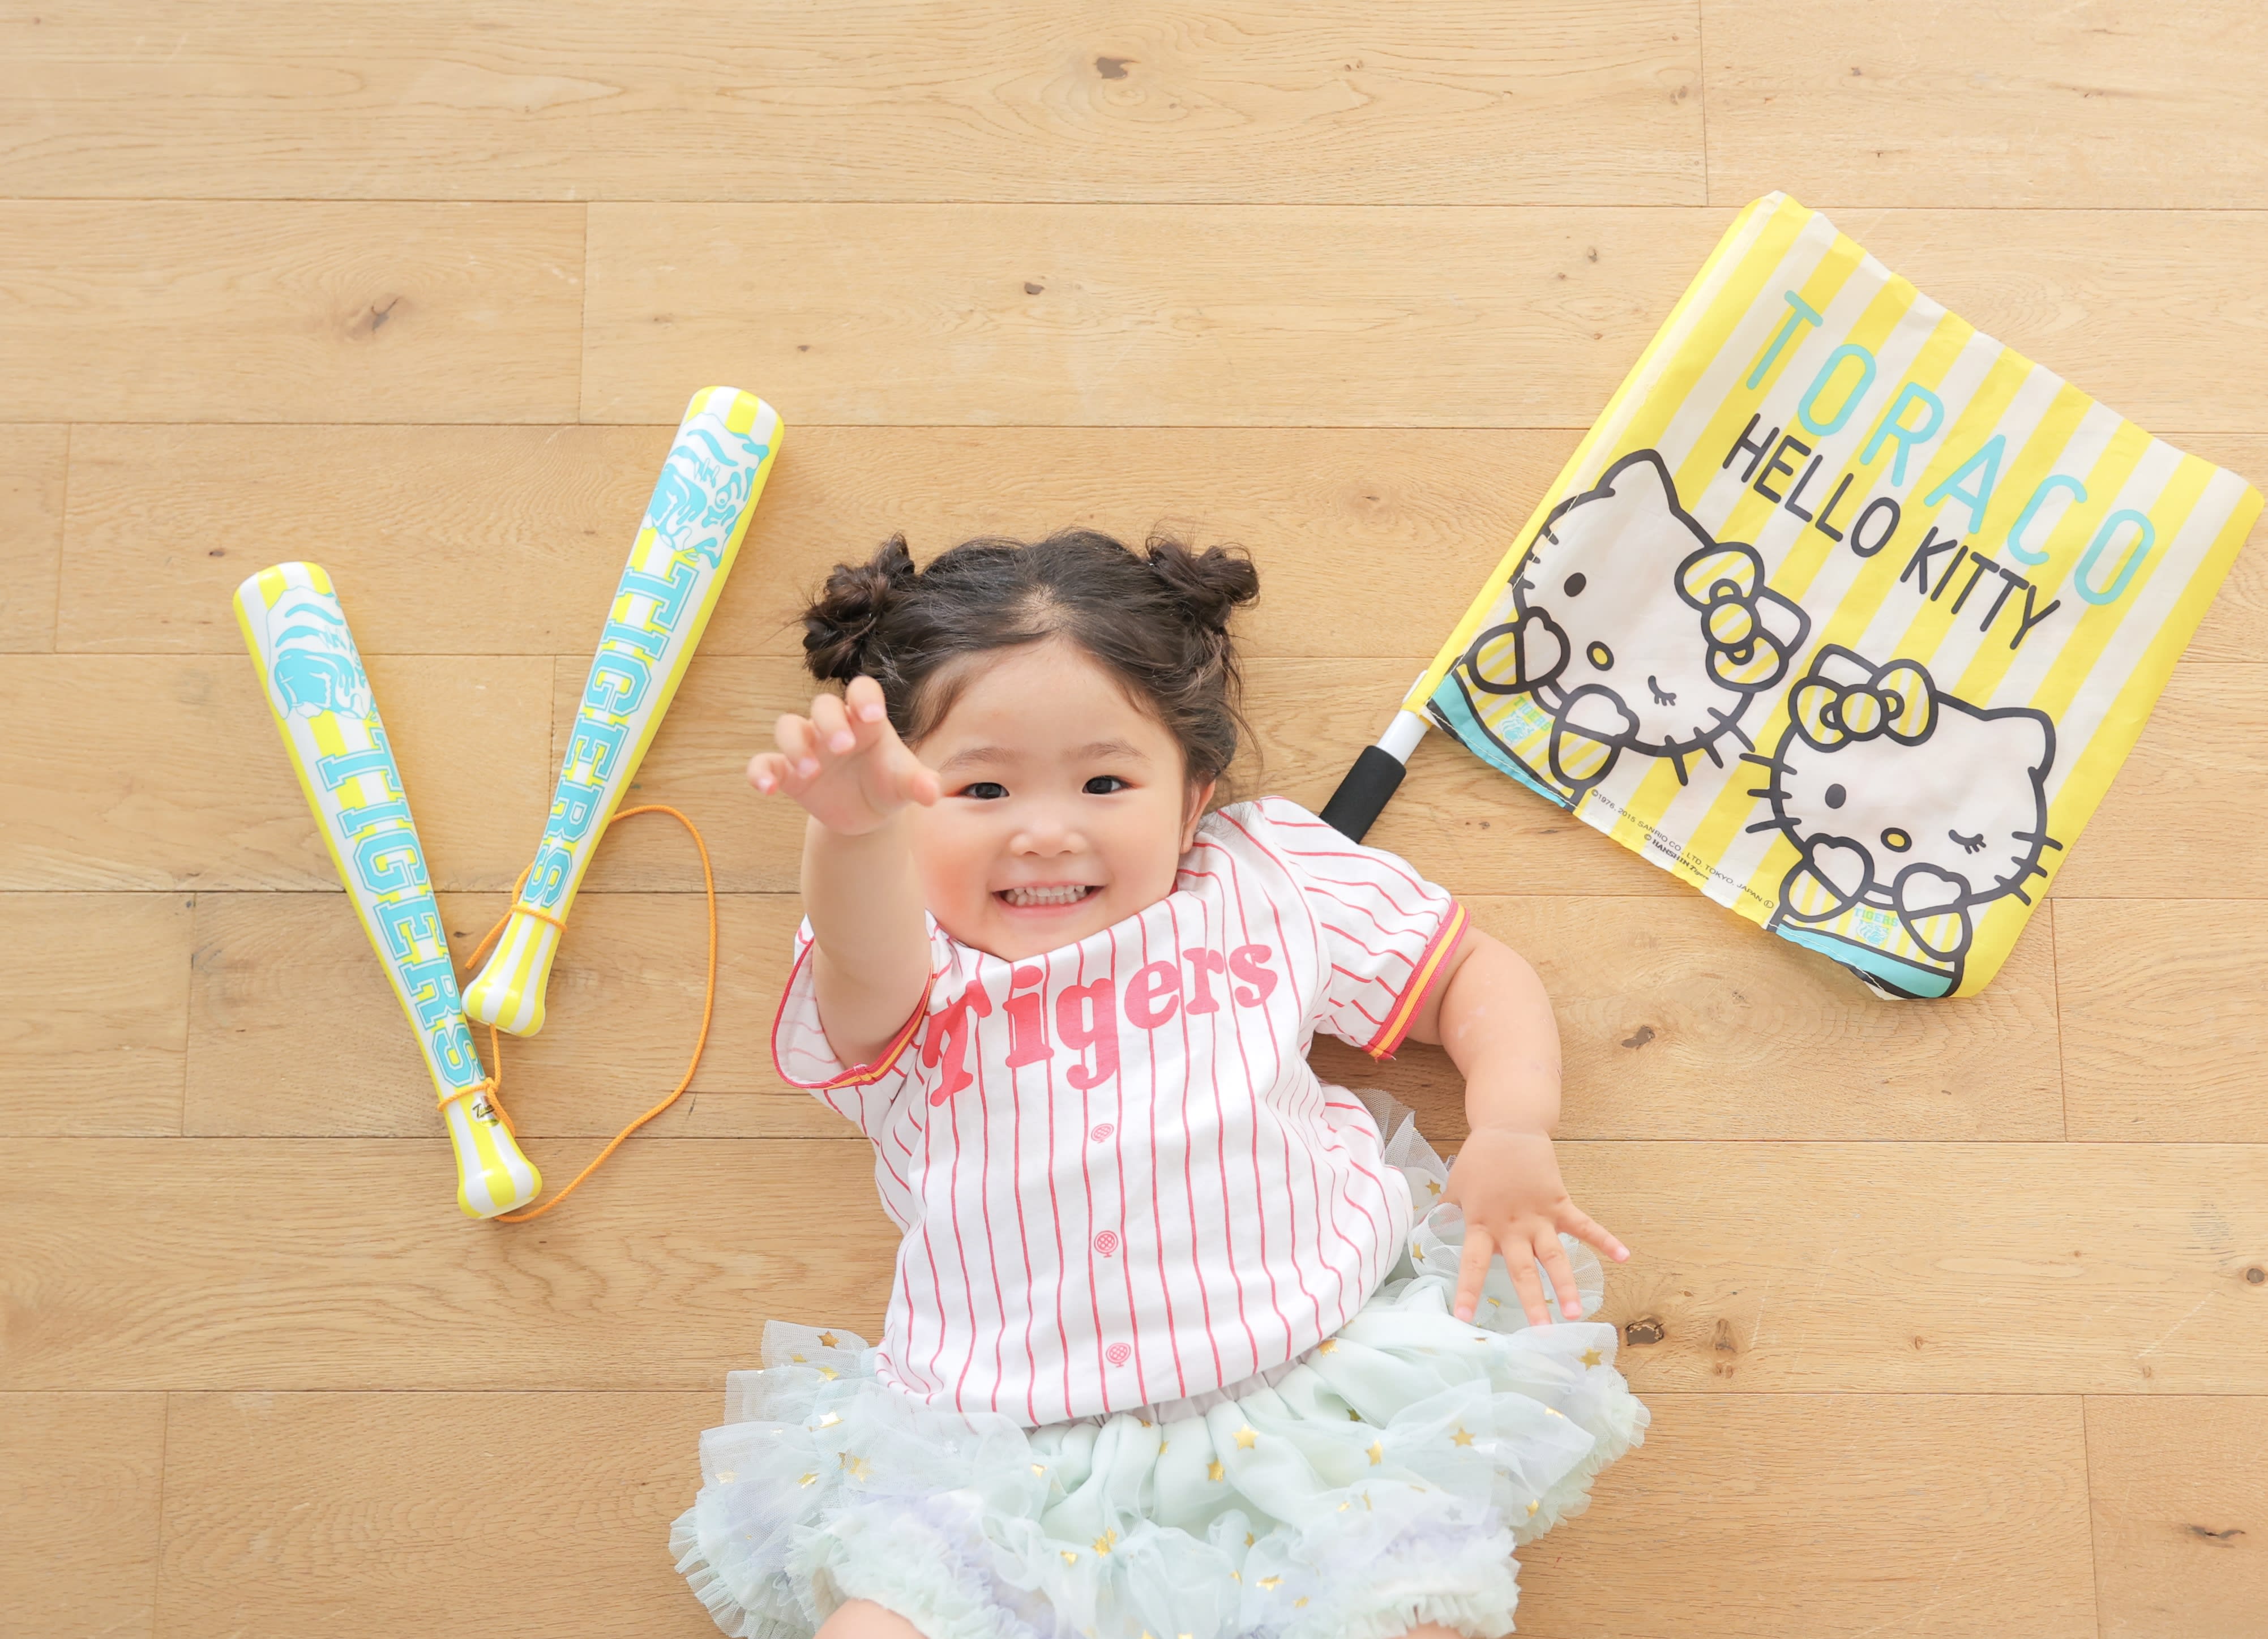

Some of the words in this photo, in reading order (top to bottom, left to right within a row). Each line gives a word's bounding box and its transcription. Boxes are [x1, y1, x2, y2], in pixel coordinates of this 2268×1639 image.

[1747, 291, 2154, 605] TORACO
[1722, 413, 1901, 558] HELLO
[1900, 527, 2061, 651] KITTY
[521, 565, 702, 908] TIGERS
[1514, 696, 1552, 731] TIGERS
[315, 727, 486, 1088] TIGERS
[1617, 807, 1636, 823] 2015
[1637, 821, 1668, 842] SANRIO
[1736, 883, 1763, 902] JAPAN
[1652, 839, 1690, 867] HANSHIN
[1689, 865, 1709, 880] Tigers
[1854, 908, 1898, 927] TIGERS
[922, 944, 1278, 1107] Tigers
